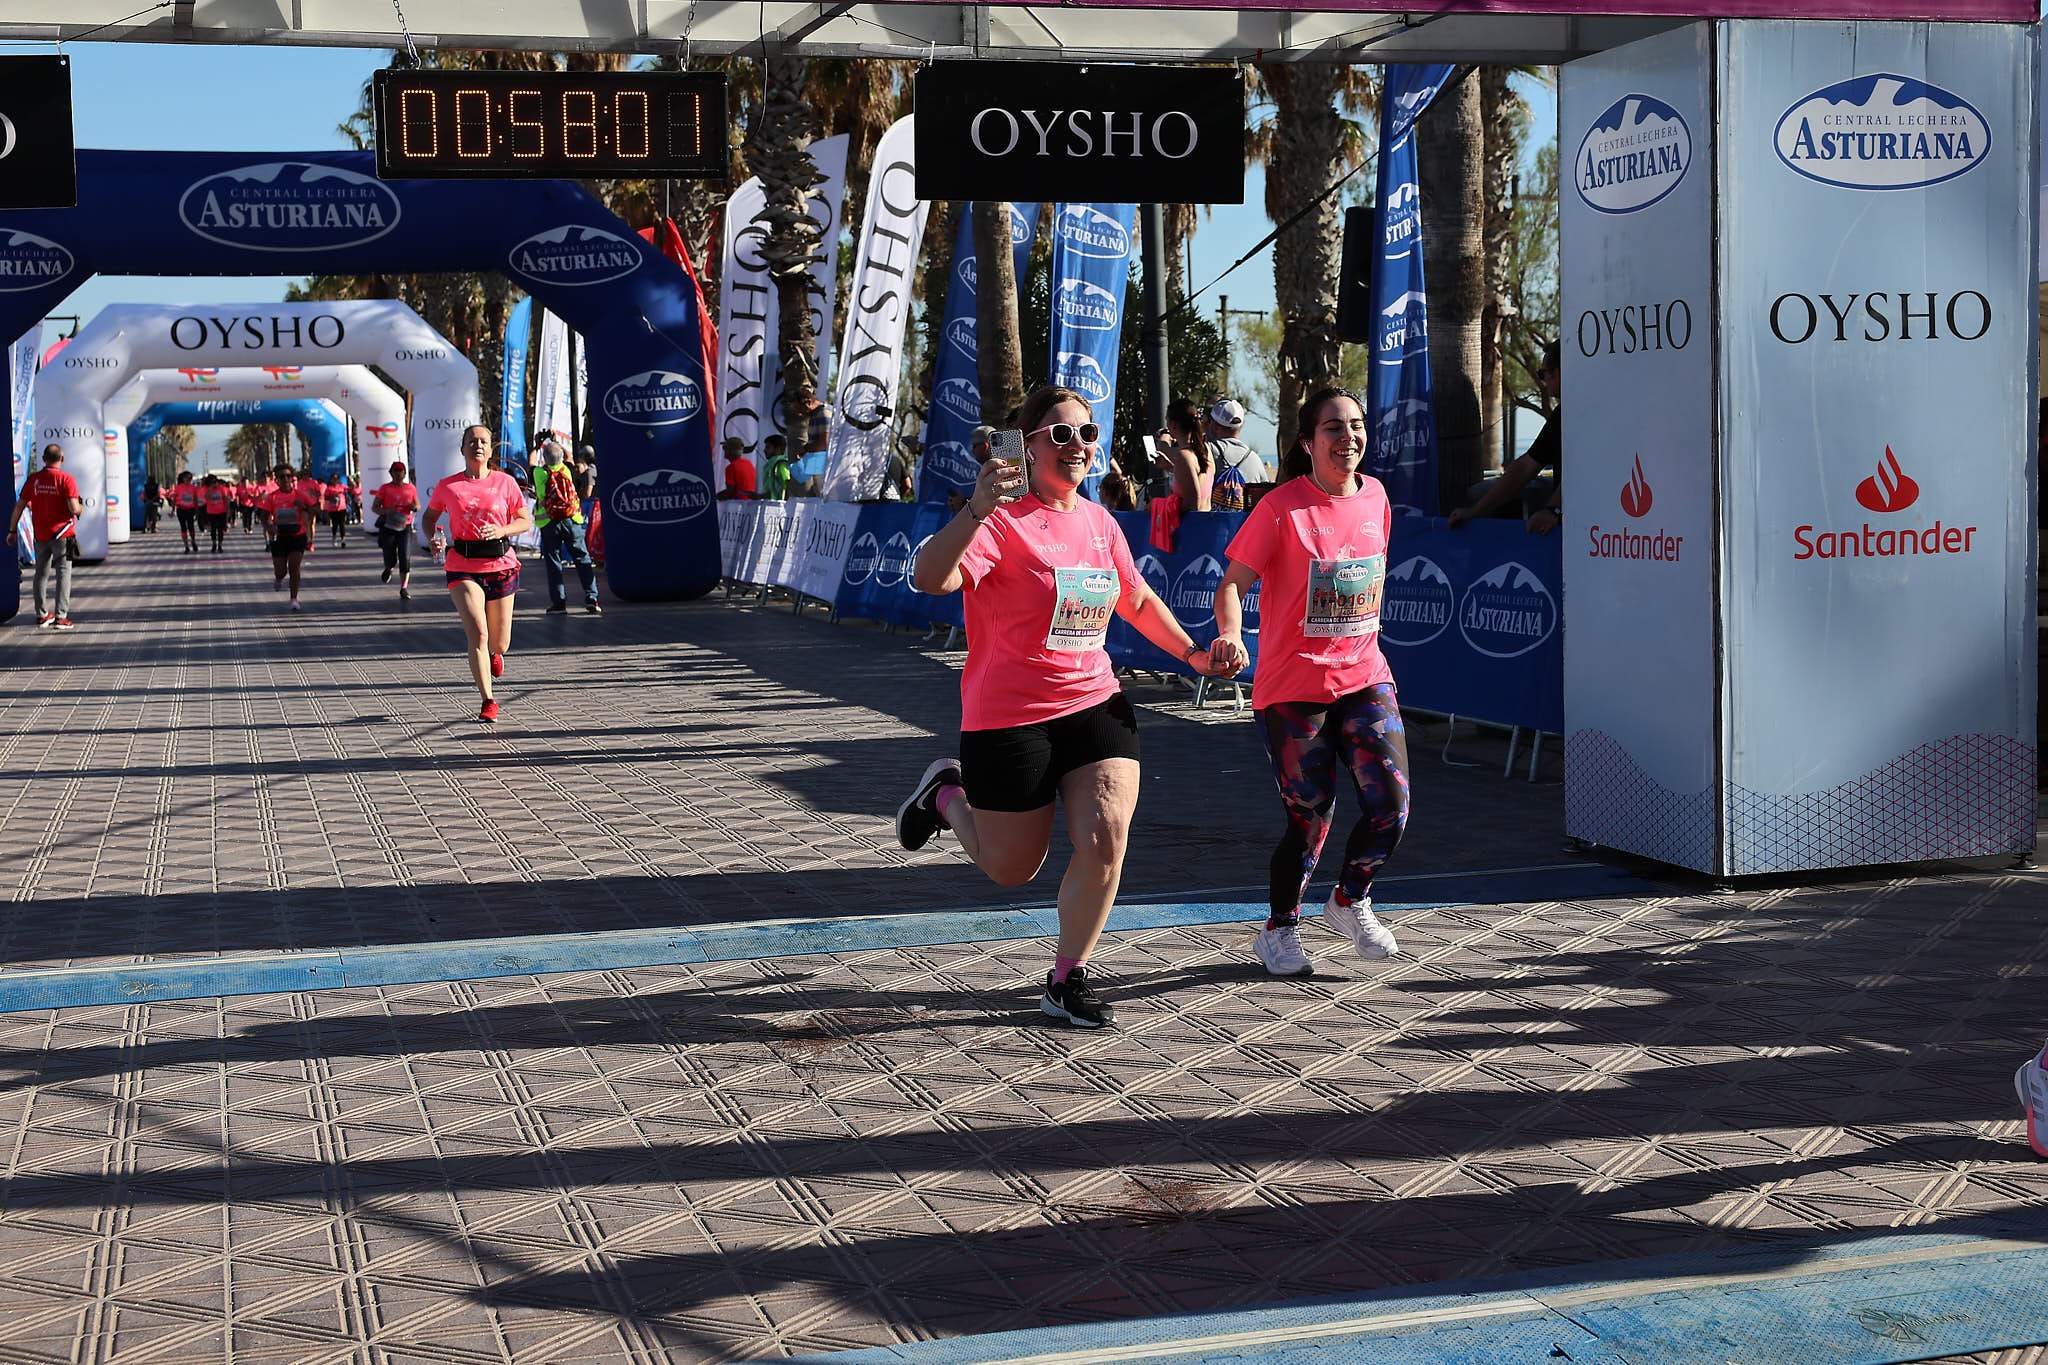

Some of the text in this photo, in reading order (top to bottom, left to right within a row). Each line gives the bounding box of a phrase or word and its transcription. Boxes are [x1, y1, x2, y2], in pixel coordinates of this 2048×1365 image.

[402, 90, 700, 158] 00:58:01
[970, 107, 1198, 158] OYSHO
[1823, 114, 1967, 126] CENTRAL LECHERA
[1598, 126, 1679, 153] CENTRAL LECHERA
[1790, 116, 1975, 161] ASTURIANA
[1581, 142, 1682, 191] ASTURIANA
[230, 188, 377, 198] CENTRAL LECHERA
[197, 189, 386, 229] ASTURIANA
[521, 251, 635, 273] ASTURIANA
[1577, 299, 1692, 358] OYSHO
[1769, 290, 1992, 345] OYSHO
[170, 314, 345, 350] OYSHO
[65, 357, 119, 369] OYSHO
[395, 349, 447, 361] OYSHO
[610, 393, 698, 414] ASTURIANA
[44, 427, 94, 440] OYSHO
[425, 418, 472, 430] OYSHO
[618, 491, 706, 513] ASTURIANA
[1588, 525, 1683, 562] Santander
[1794, 520, 1977, 561] Santander
[1081, 606, 1106, 620] 016
[1463, 593, 1543, 636] ASTURIANA
[1056, 639, 1083, 647] OYSHO
